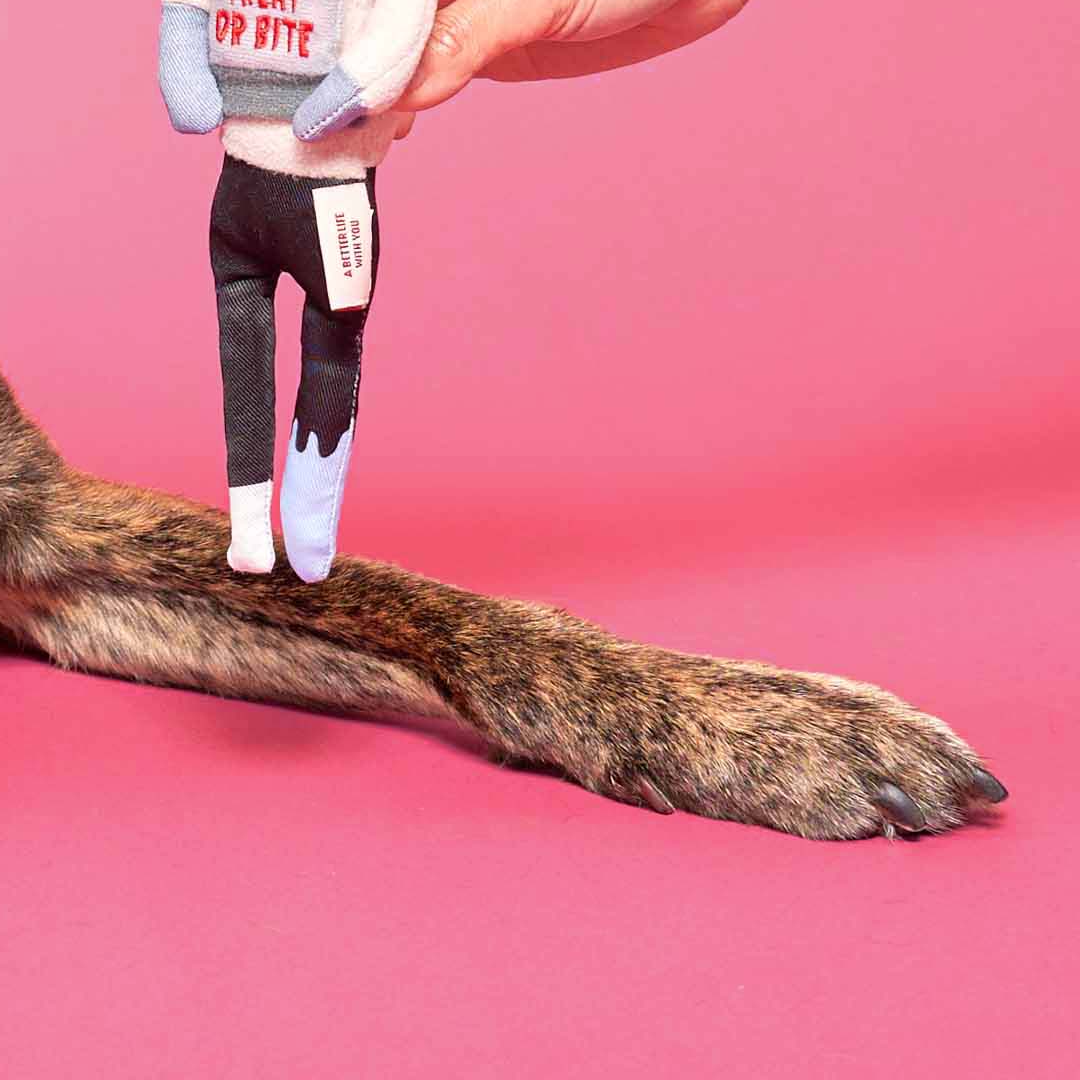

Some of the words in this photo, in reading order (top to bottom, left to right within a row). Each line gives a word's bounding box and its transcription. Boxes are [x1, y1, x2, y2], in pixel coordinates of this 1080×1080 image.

[216, 9, 247, 46] OR
[255, 15, 314, 58] BITE
[335, 212, 346, 231] LIFE
[350, 220, 361, 240] YOU
[338, 233, 352, 269] BETTER
[353, 242, 363, 268] WITH
[344, 269, 353, 278] A
